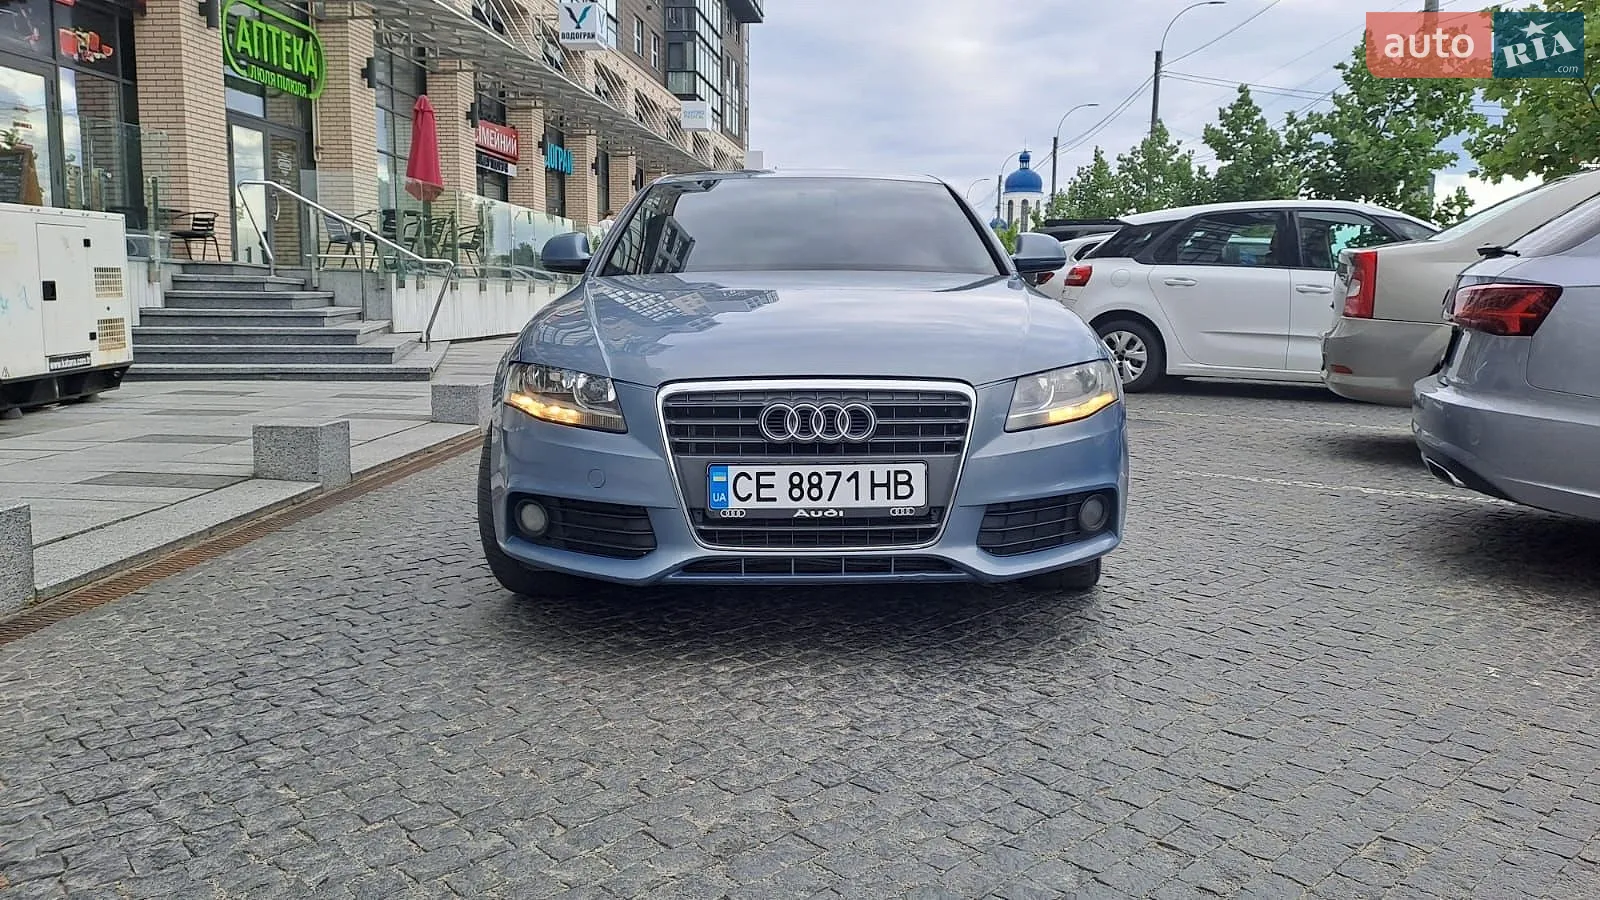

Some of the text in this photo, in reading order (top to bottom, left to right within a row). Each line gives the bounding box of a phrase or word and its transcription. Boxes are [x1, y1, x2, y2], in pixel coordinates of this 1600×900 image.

[236, 15, 318, 80] АПТЕКА
[712, 493, 726, 502] UA
[732, 470, 915, 502] CE 8871 HB
